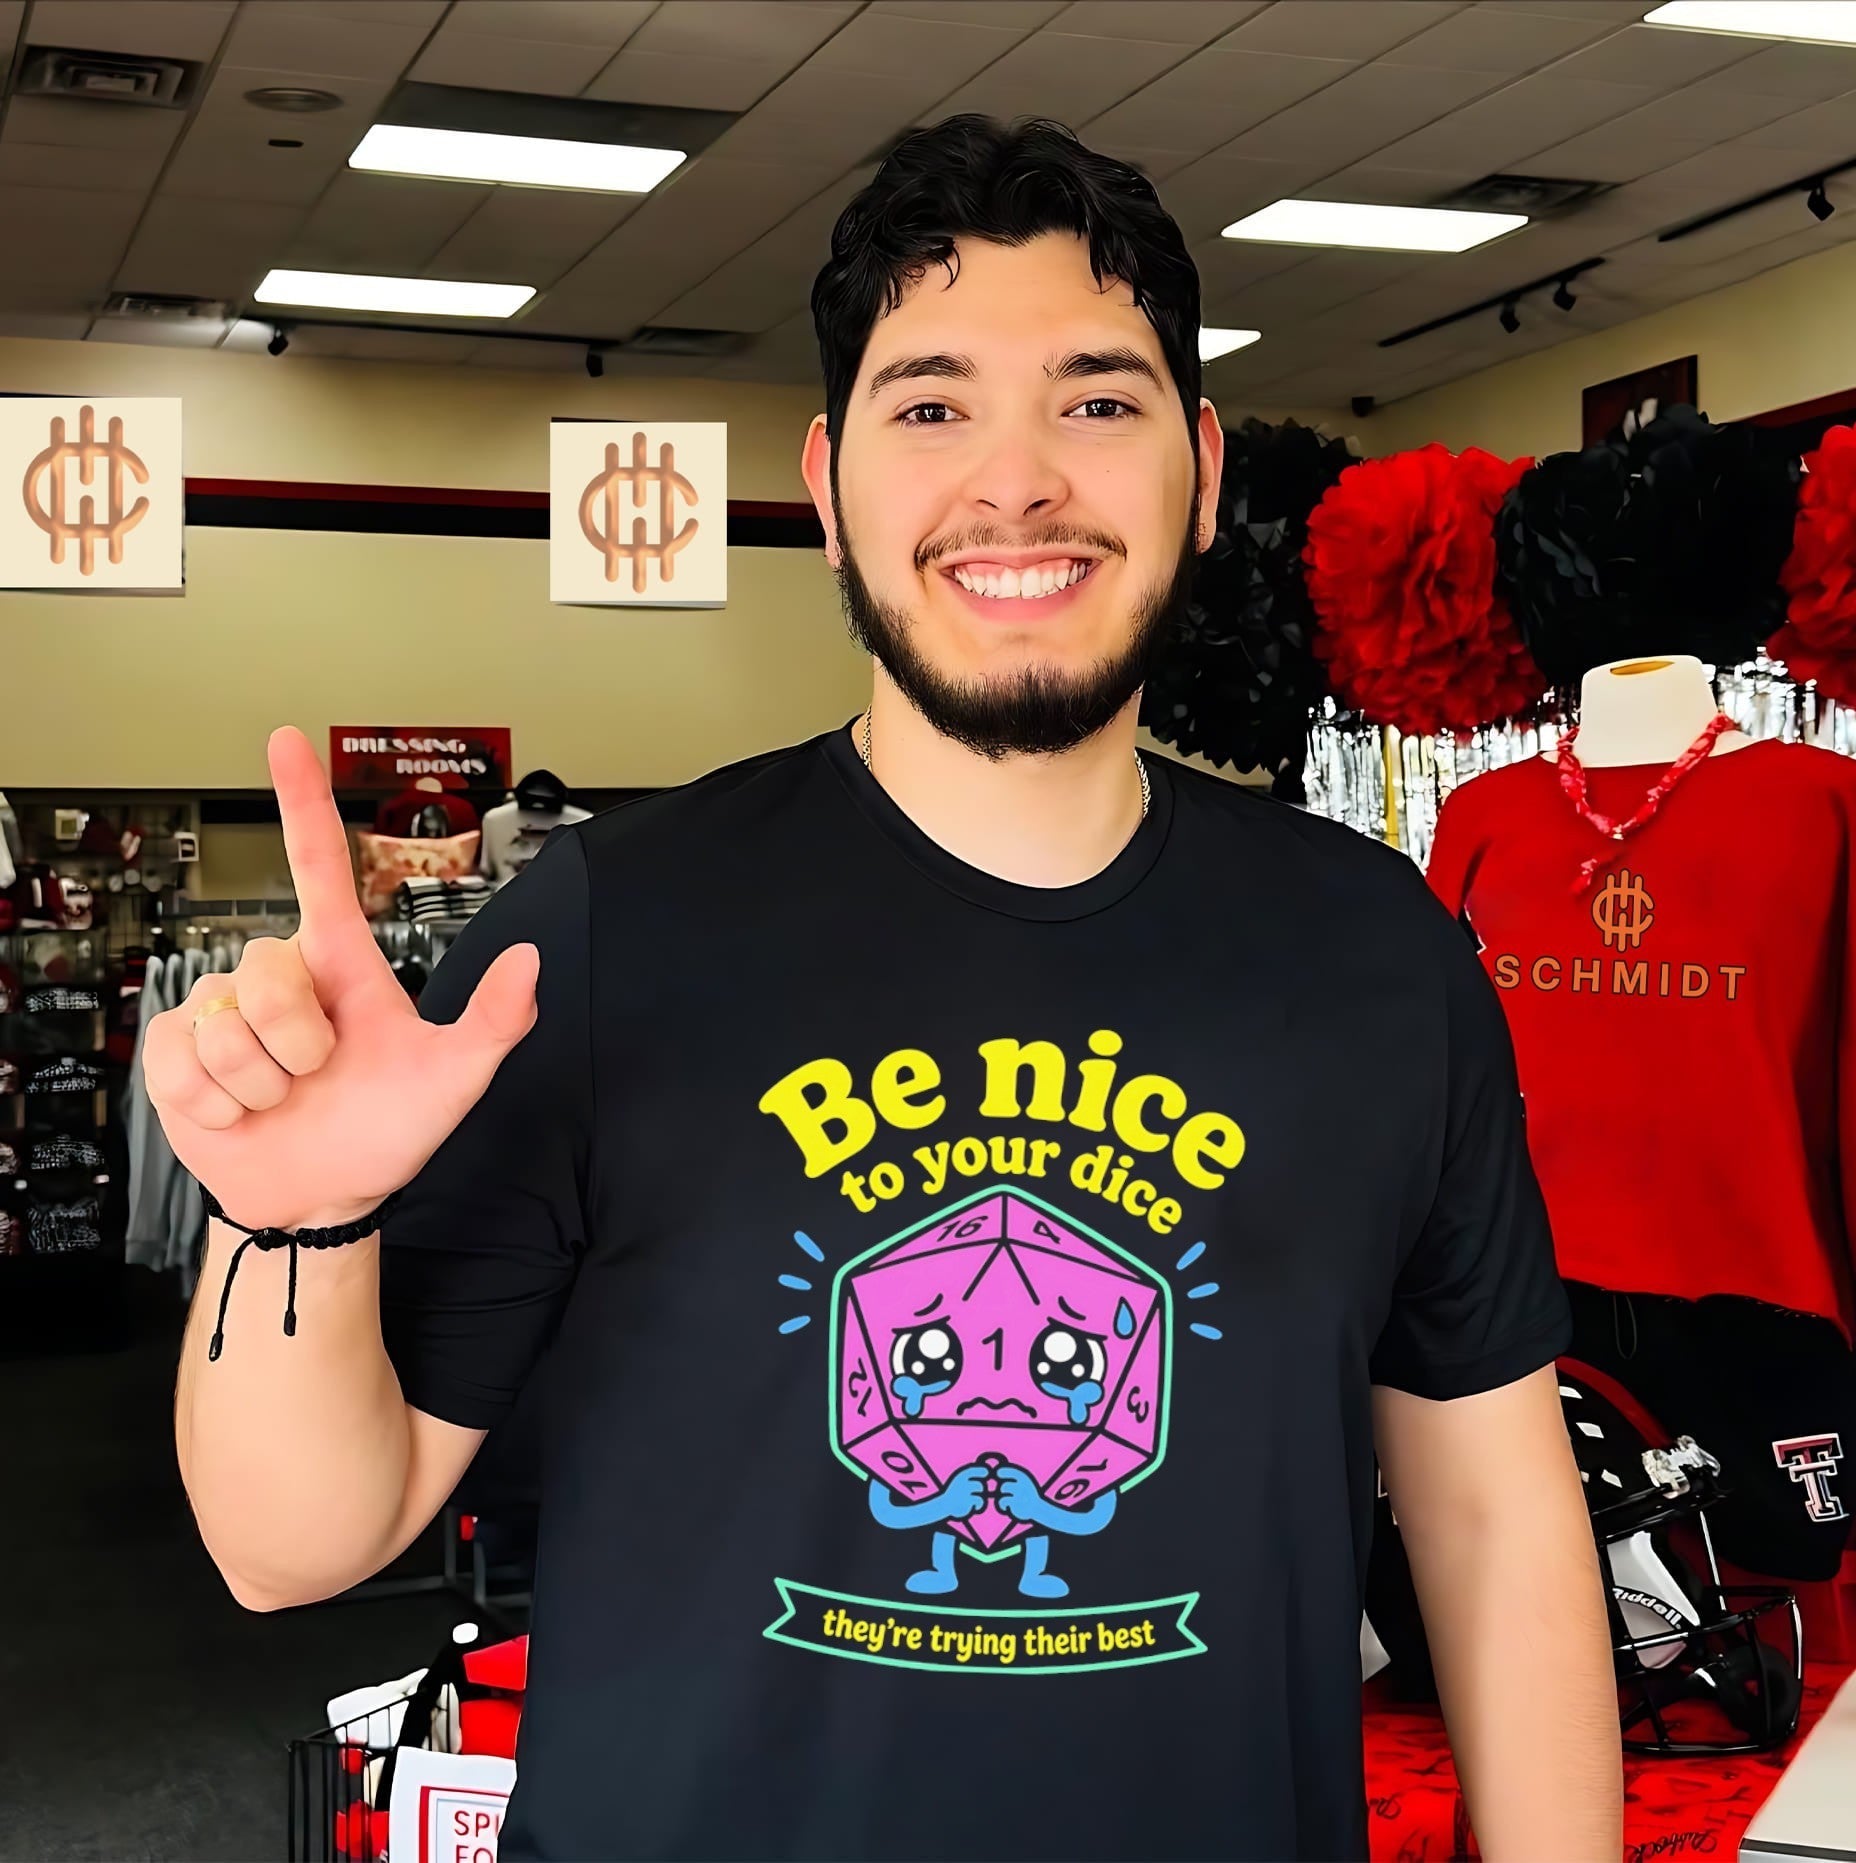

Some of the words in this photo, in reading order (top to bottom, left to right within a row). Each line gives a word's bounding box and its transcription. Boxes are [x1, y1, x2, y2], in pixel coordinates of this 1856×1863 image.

[342, 737, 467, 754] DRESSING
[396, 758, 487, 775] ROOMS
[1494, 954, 1746, 1000] SCHMIDT
[759, 1049, 946, 1178] Be
[979, 1030, 1245, 1189] nice
[841, 1162, 904, 1212] to
[913, 1136, 1060, 1194] your
[1070, 1145, 1182, 1234] dice
[937, 1215, 989, 1242] 16
[1032, 1220, 1061, 1245] 4
[981, 1327, 1004, 1371] 1
[1126, 1385, 1150, 1424] 3
[822, 1608, 923, 1653] they're
[929, 1624, 1017, 1664] trying
[1023, 1624, 1093, 1656] their
[1096, 1619, 1156, 1652] best
